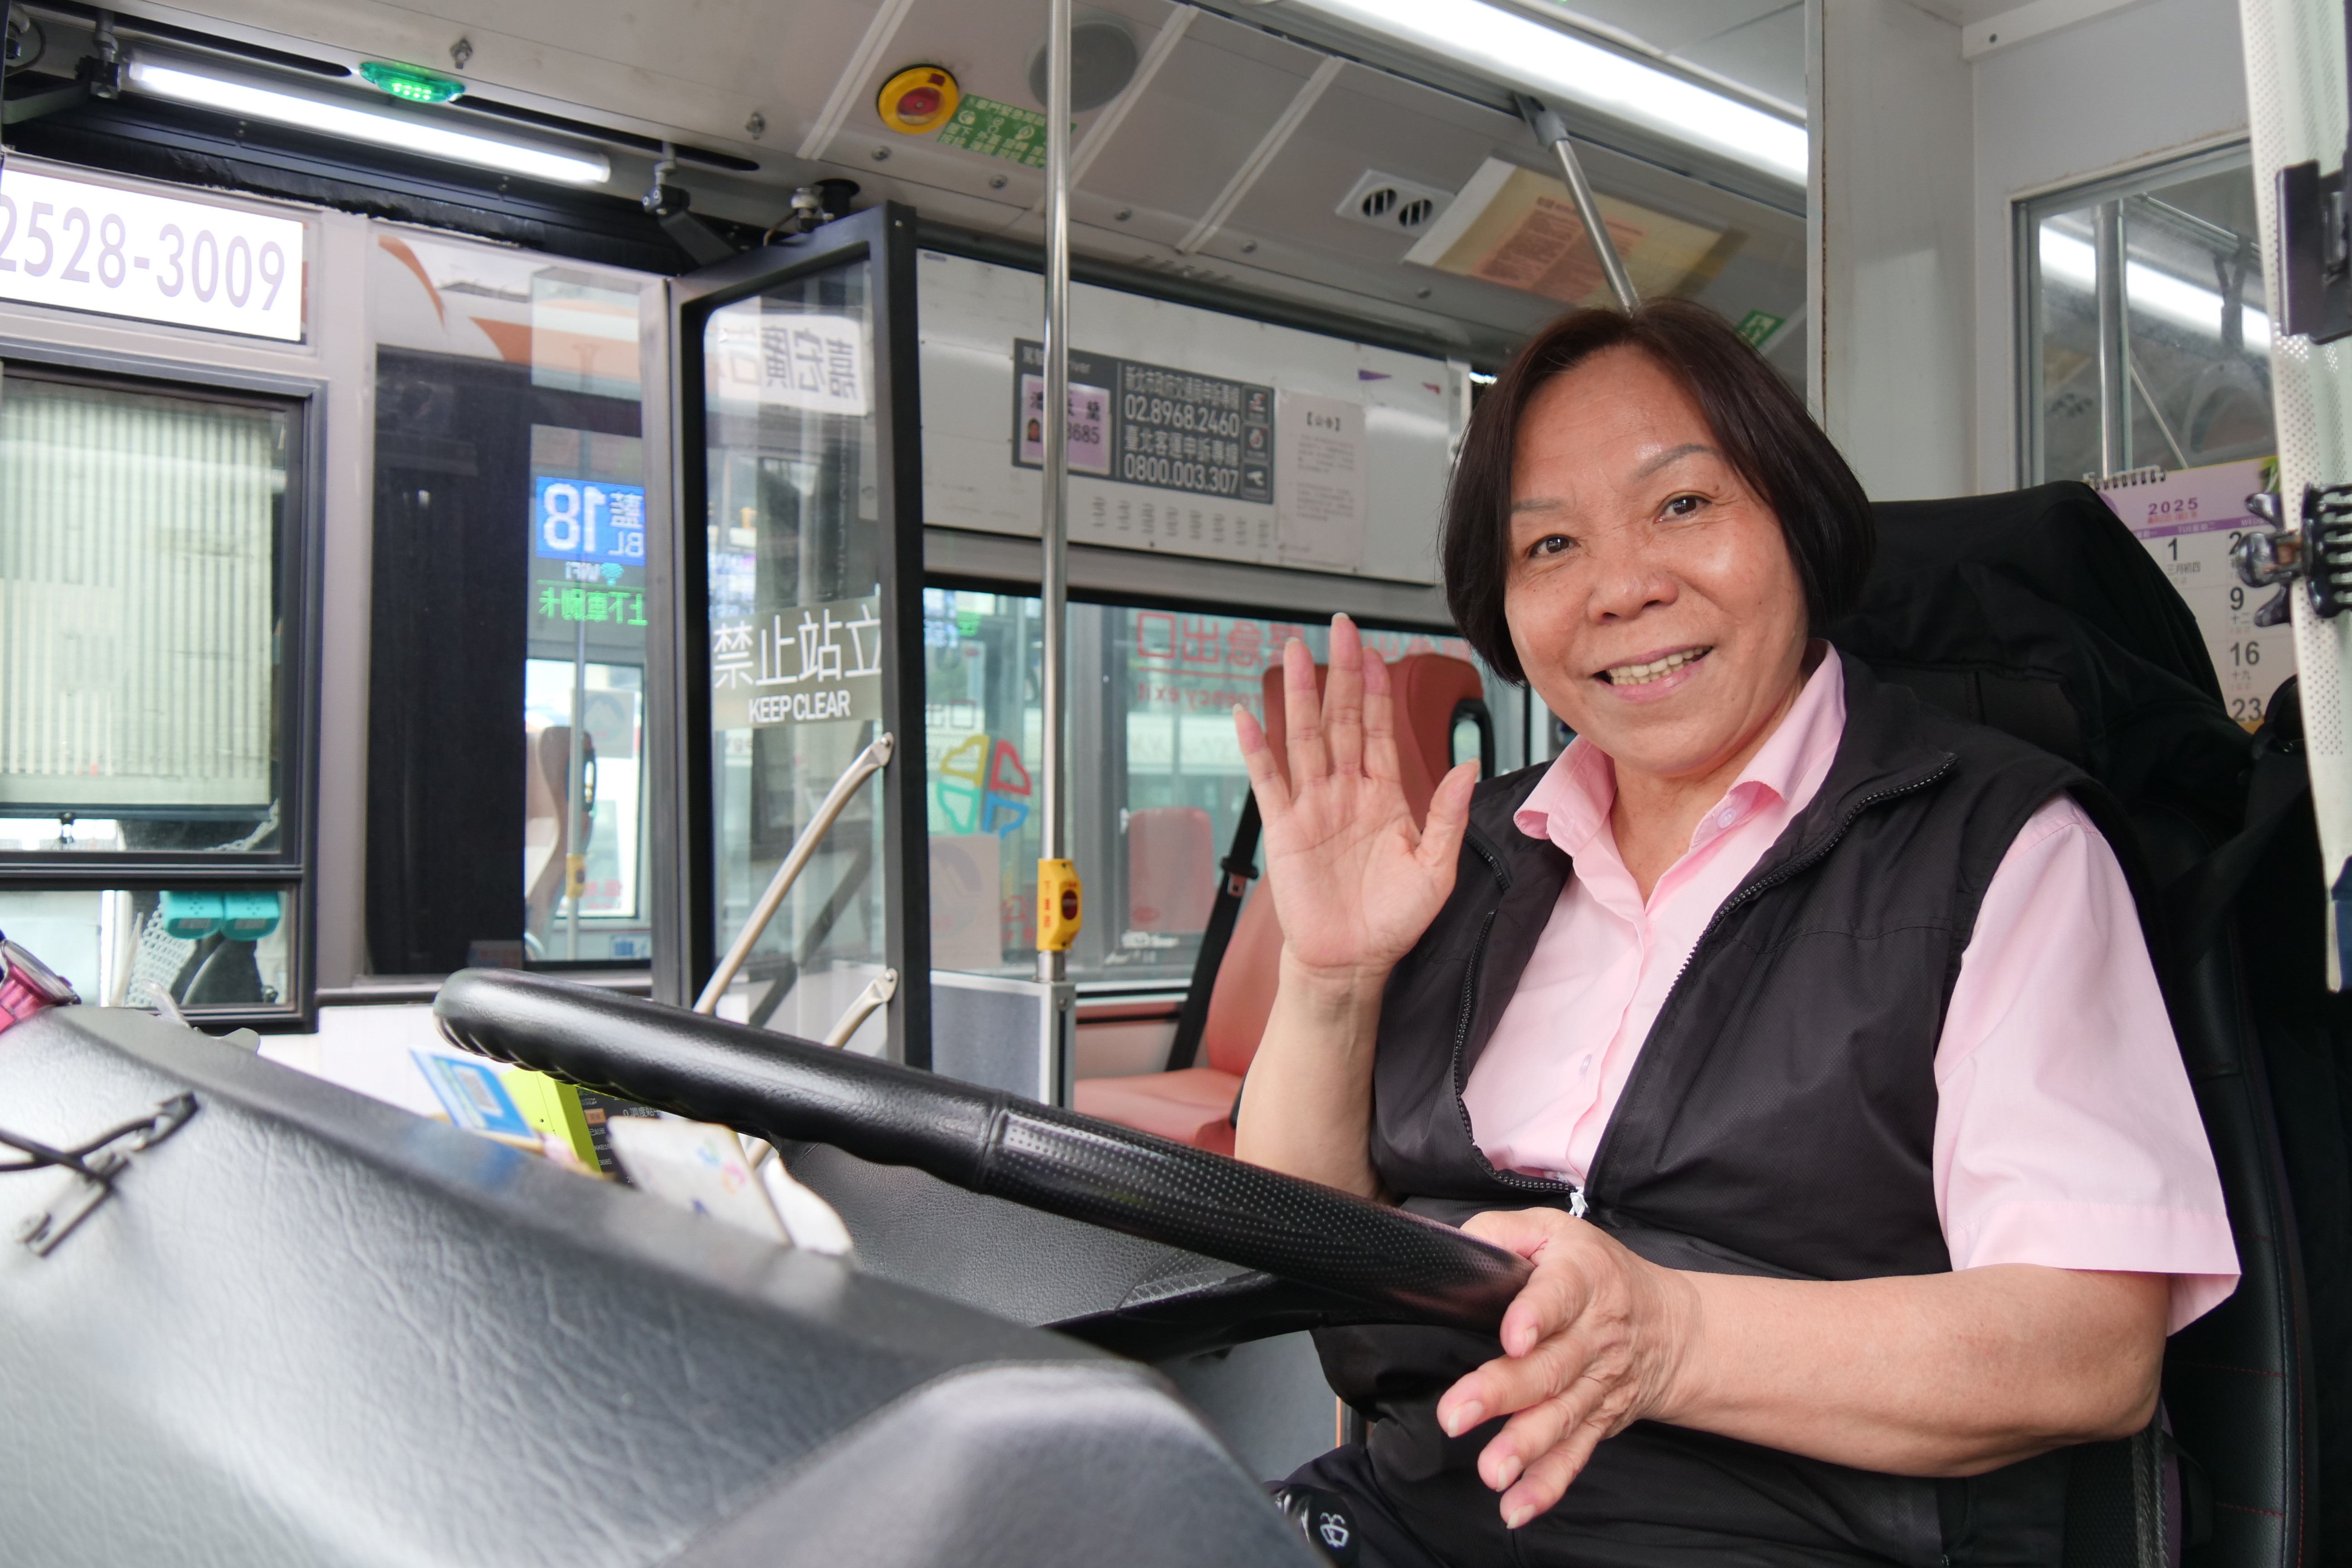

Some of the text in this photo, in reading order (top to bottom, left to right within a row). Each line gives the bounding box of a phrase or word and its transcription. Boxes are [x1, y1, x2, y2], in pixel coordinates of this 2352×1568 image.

[0, 194, 285, 311] 2528-3009
[1124, 393, 1240, 438] 02.8968.2460
[1124, 453, 1240, 495] 0800.003.307
[2148, 497, 2199, 515] 2025
[2167, 537, 2178, 561] 1
[2230, 587, 2244, 610] 9
[713, 604, 882, 690] 禁止站立
[2230, 641, 2260, 666] 16
[748, 689, 852, 724] KEEP CLEAR
[2233, 697, 2263, 722] 23
